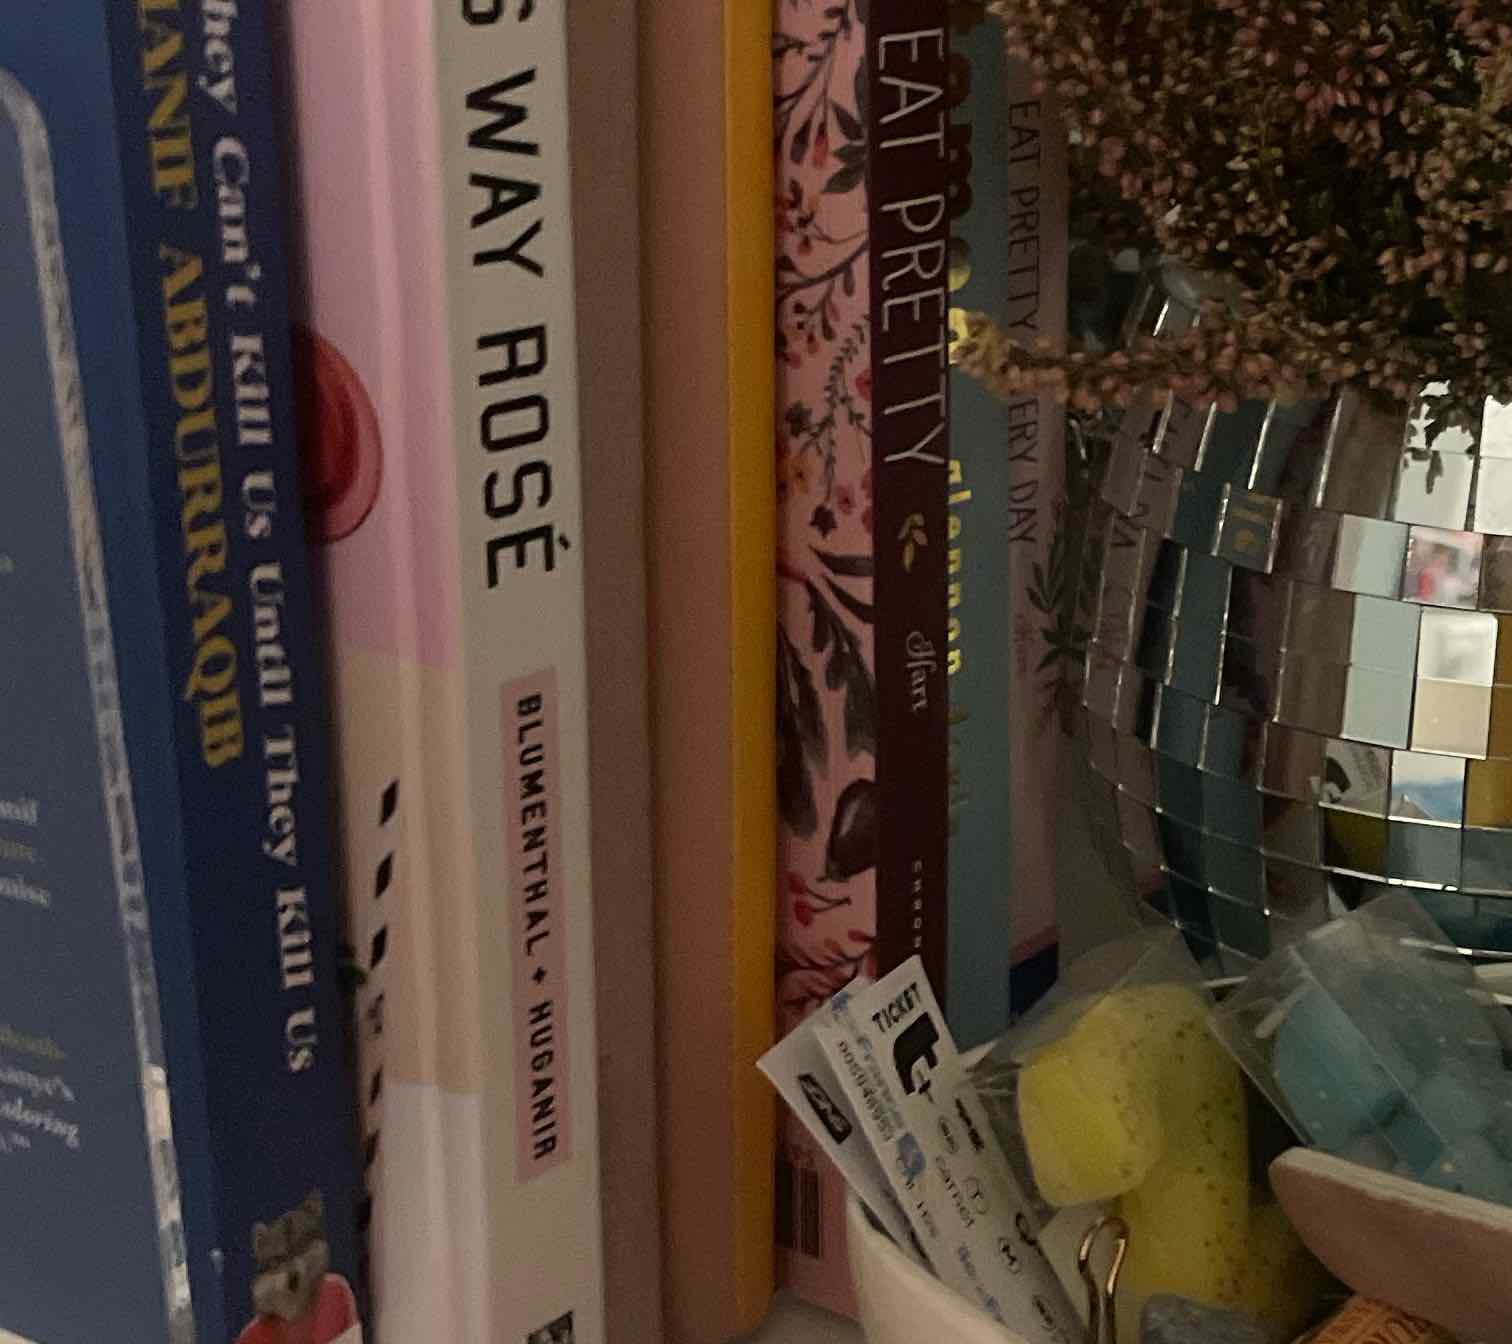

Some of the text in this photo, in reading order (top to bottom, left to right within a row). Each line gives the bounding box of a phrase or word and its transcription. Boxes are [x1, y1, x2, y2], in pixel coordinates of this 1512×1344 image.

[212, 135, 263, 308] Can't
[464, 67, 545, 279] WAY
[877, 27, 948, 467] EAT PRETTY
[230, 333, 273, 447] Kill
[1008, 99, 1041, 545] EAT PRETTY ERY DAY
[157, 242, 245, 769] ABDURRAQIB
[241, 468, 277, 541] Us
[475, 323, 571, 590] ROSÉ
[249, 560, 293, 707] Until
[262, 724, 300, 870] They
[516, 692, 551, 958] BLUMENTHAL
[275, 885, 316, 991] Kill
[872, 981, 923, 1033] TICKET
[286, 1006, 319, 1074] Us
[526, 1000, 559, 1162] HUGANIR
